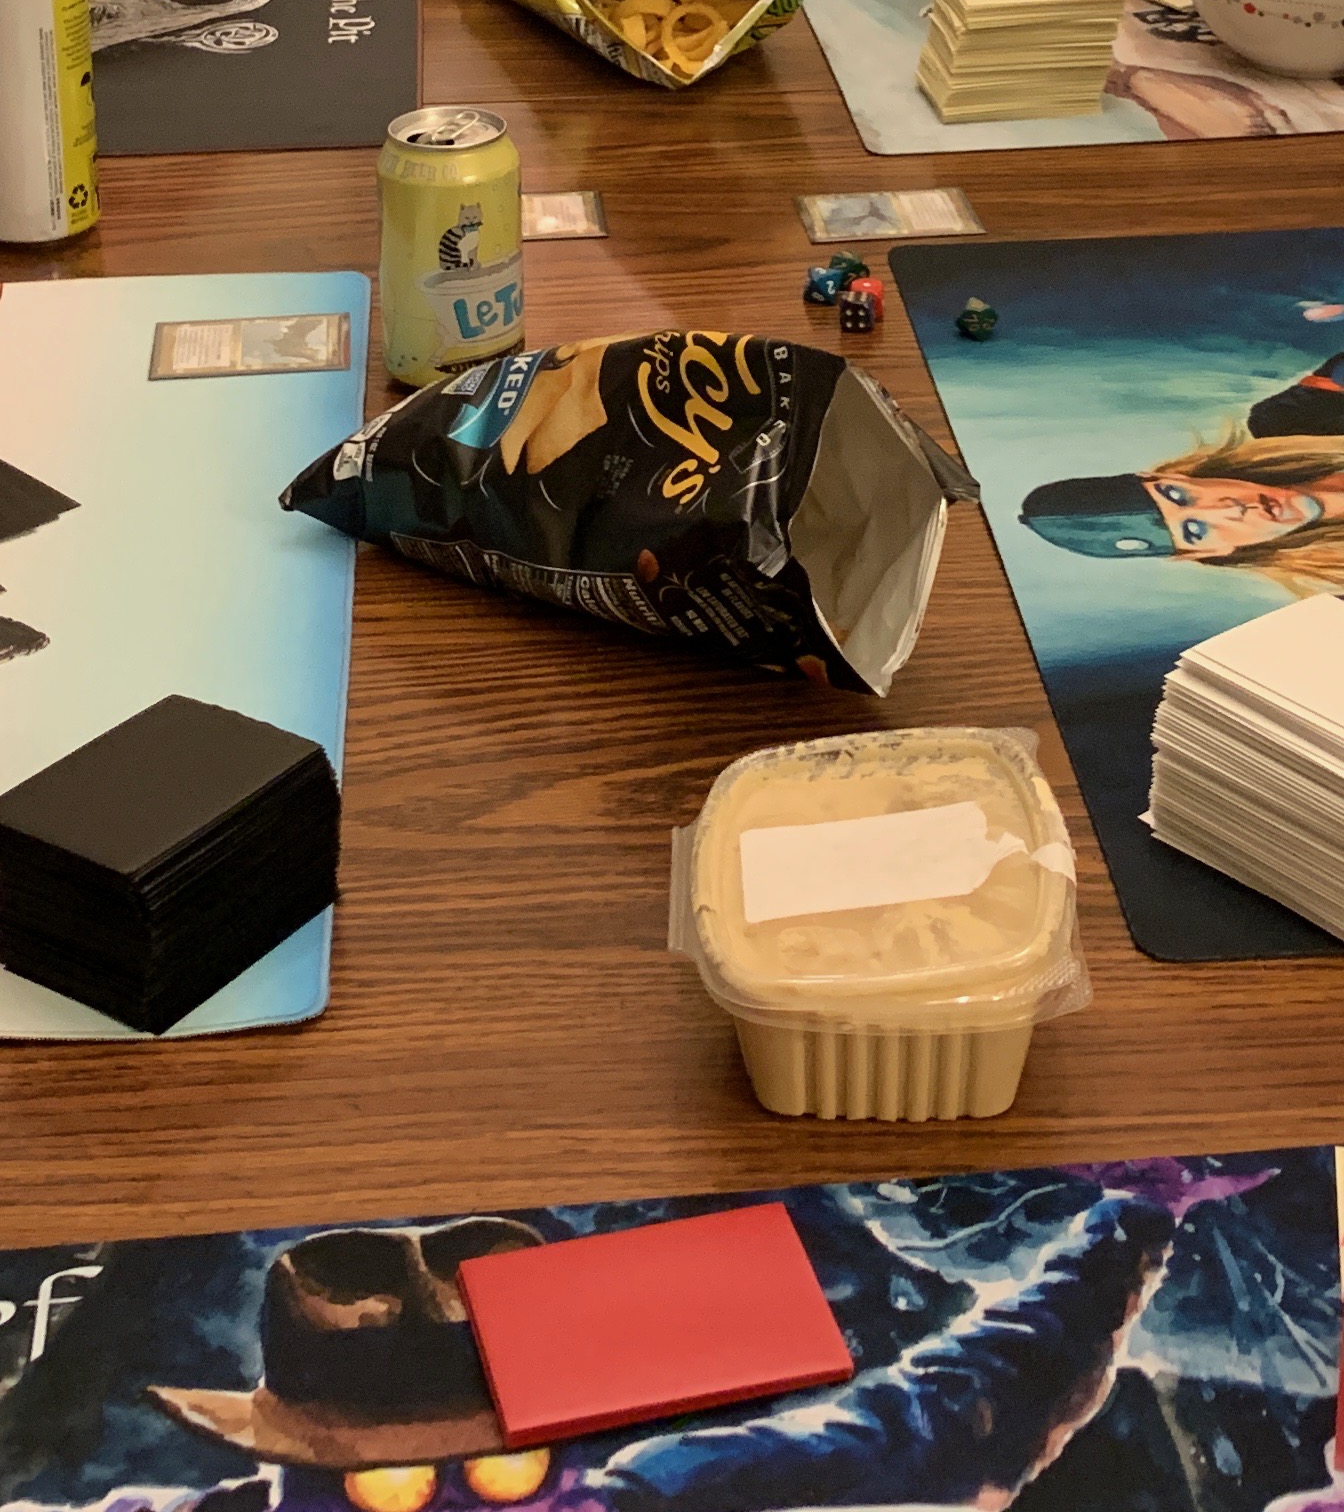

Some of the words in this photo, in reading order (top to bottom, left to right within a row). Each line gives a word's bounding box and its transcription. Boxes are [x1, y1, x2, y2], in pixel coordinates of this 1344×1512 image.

[327, 15, 376, 44] Pit
[497, 355, 534, 411] KED
[642, 330, 681, 395] hips
[622, 577, 662, 627] Nutrit
